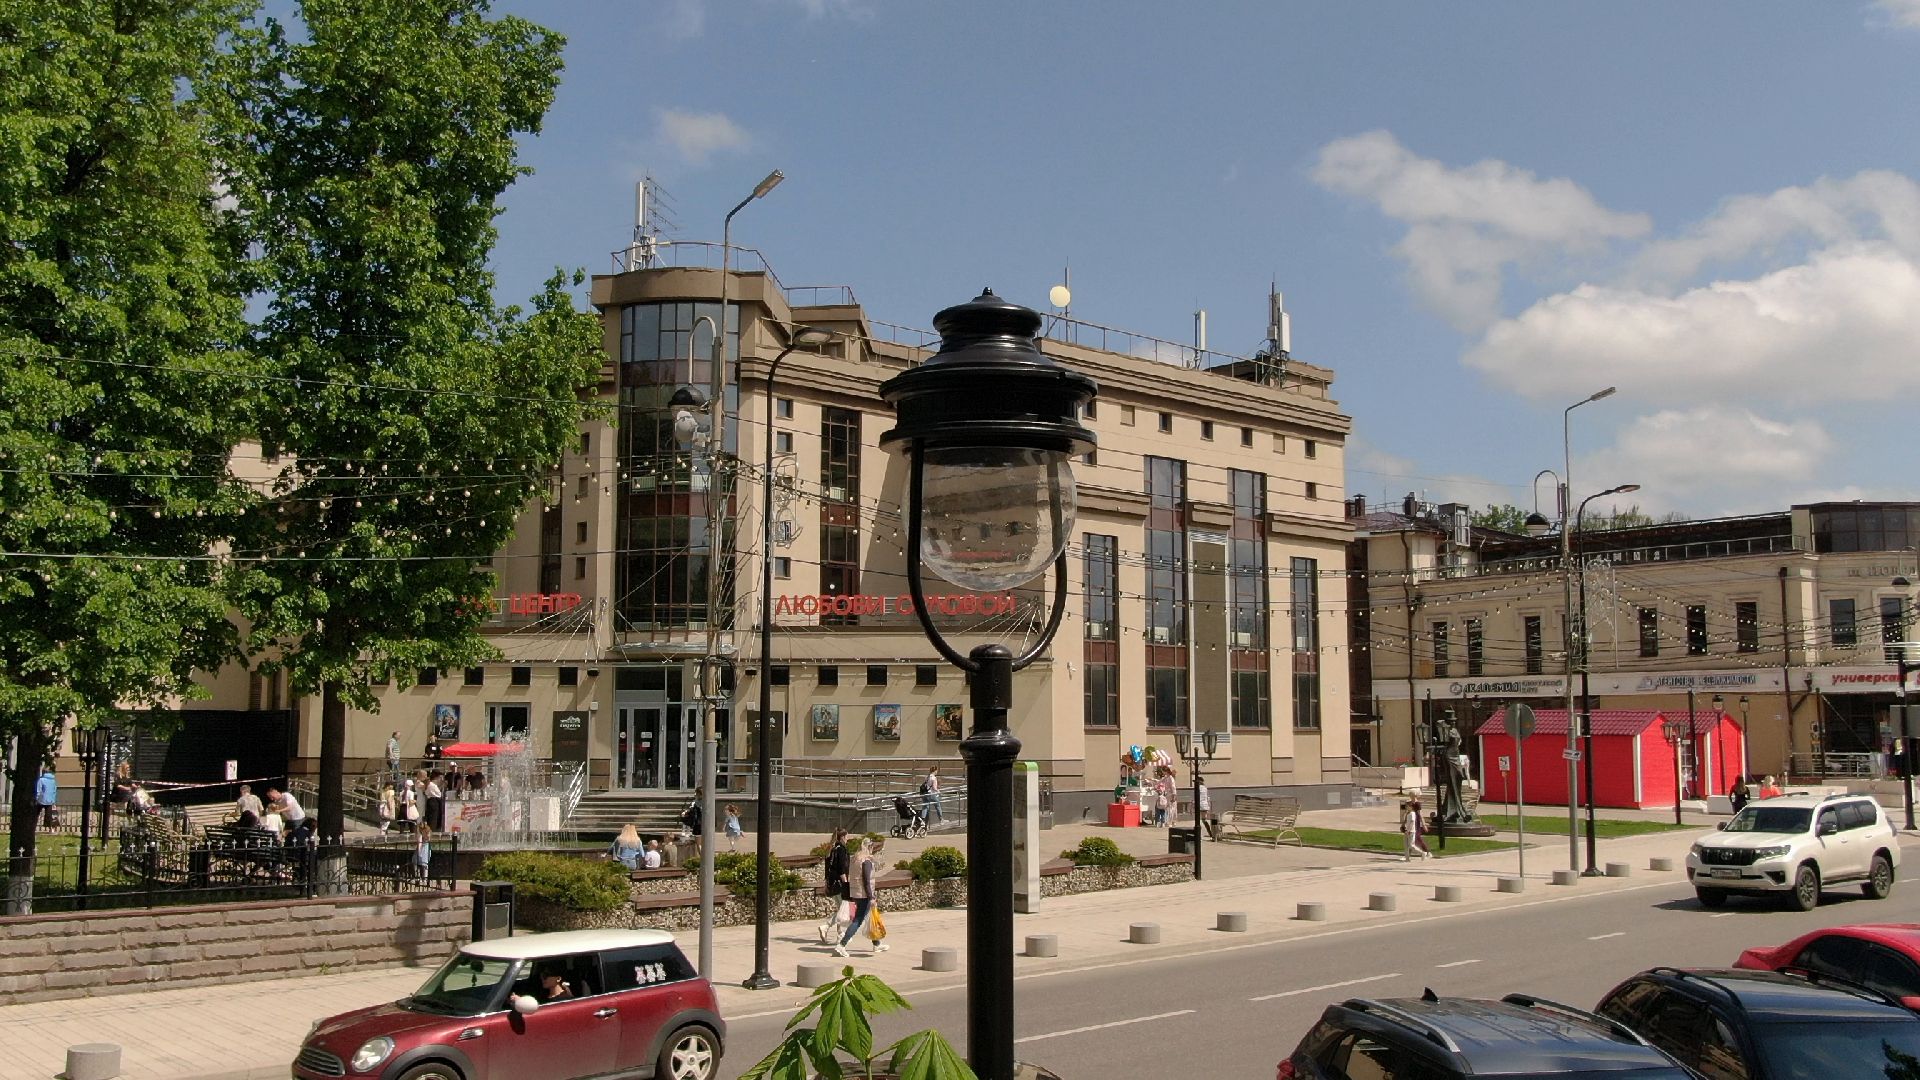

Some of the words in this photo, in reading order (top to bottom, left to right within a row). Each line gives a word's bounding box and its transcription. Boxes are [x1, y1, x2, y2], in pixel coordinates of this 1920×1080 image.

[510, 592, 581, 616] ЦЕНТР
[775, 594, 884, 616] ЛЮБОВИ
[895, 591, 1016, 615] ОЛОВОЙ
